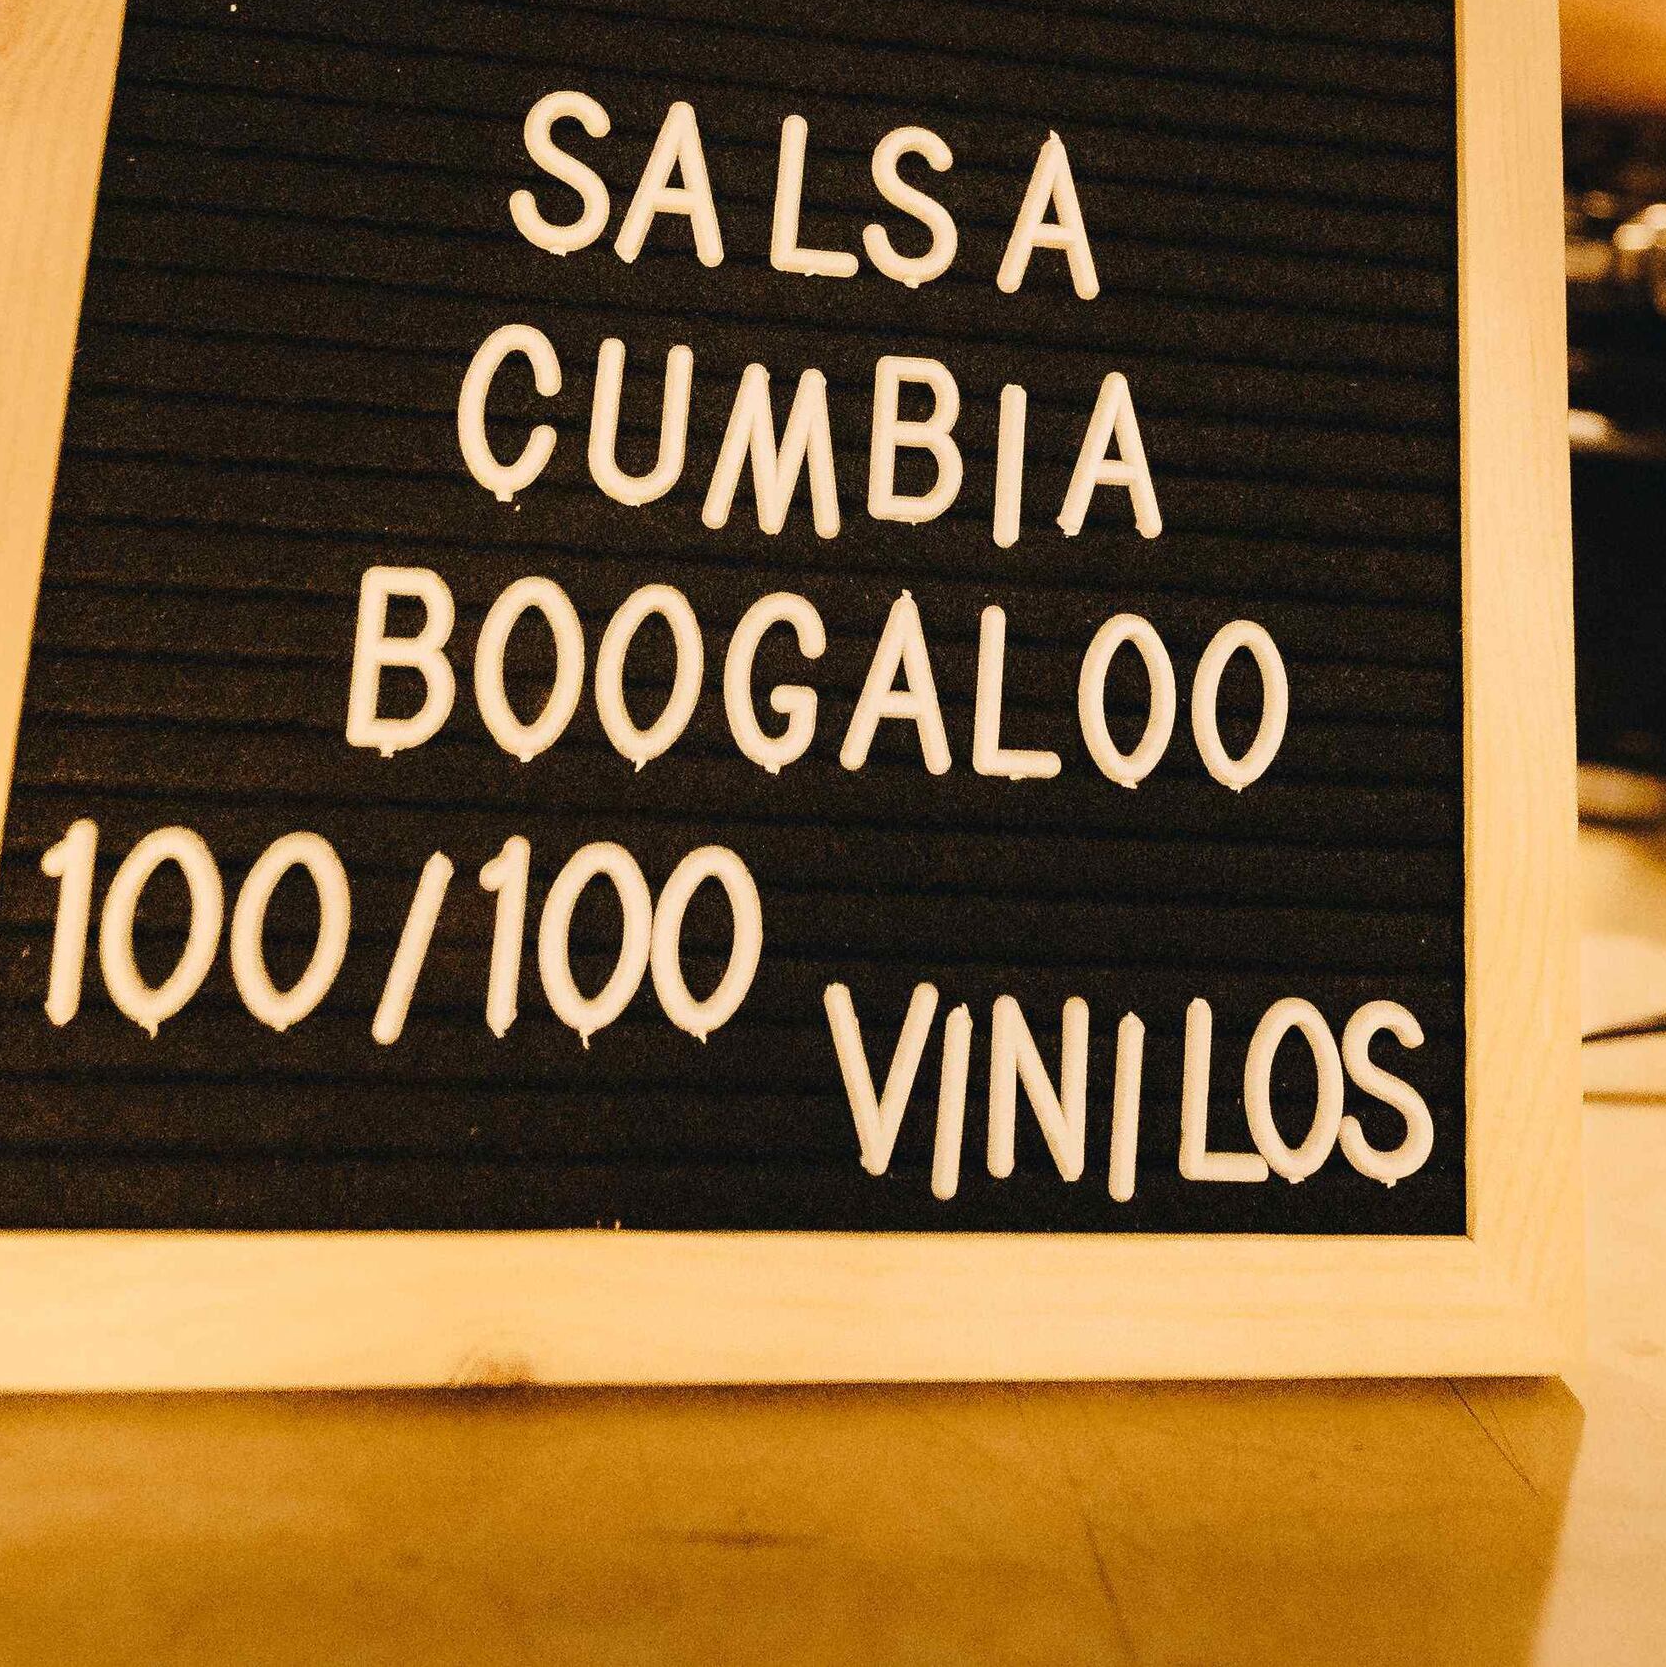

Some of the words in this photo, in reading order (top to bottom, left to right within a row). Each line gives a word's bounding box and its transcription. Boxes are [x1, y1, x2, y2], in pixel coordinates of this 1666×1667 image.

[508, 90, 1100, 301] SALSA
[457, 323, 1163, 549] CUMBIA
[345, 565, 1289, 794] BOOGALOO
[41, 819, 763, 1050] 100/100
[823, 982, 1434, 1202] VINILOS
